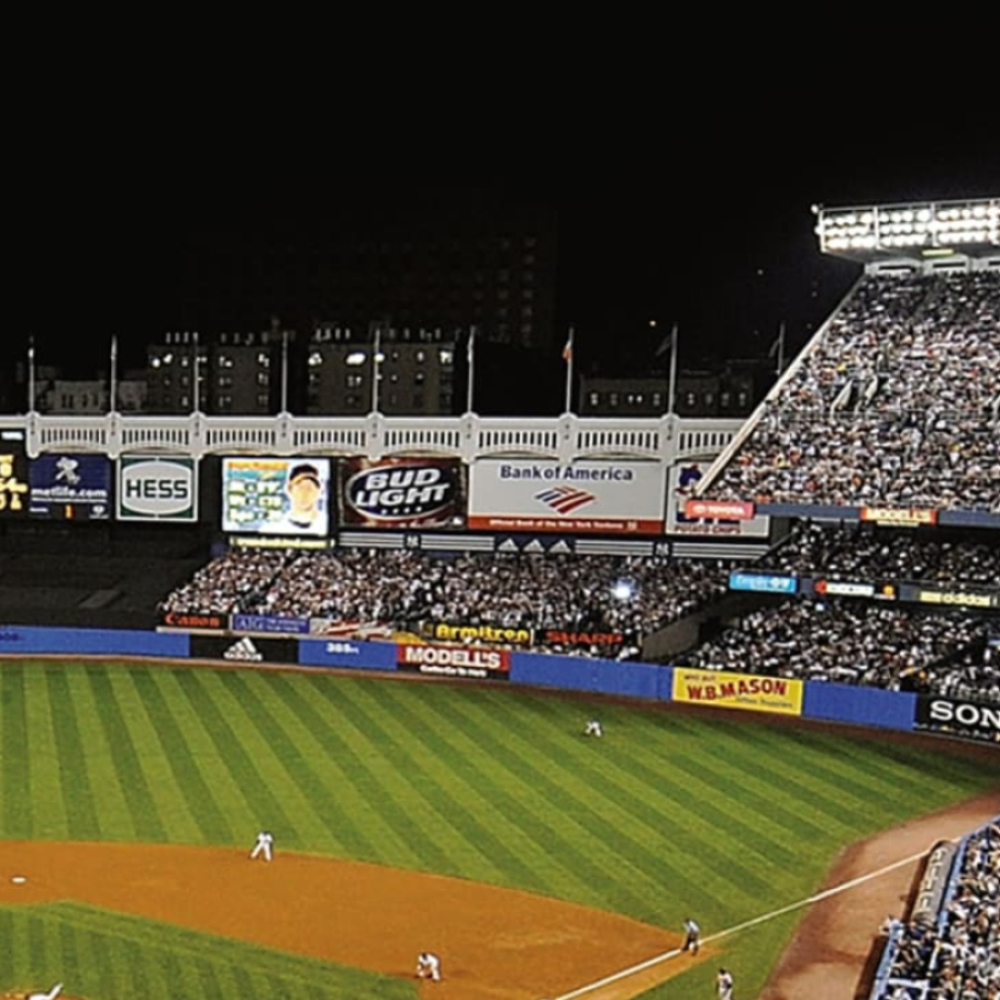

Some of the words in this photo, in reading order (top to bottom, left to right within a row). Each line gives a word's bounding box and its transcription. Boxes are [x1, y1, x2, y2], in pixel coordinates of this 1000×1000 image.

[365, 467, 441, 490] BUD
[500, 465, 541, 479] Bank
[542, 466, 562, 480] of
[563, 467, 633, 481] America
[31, 486, 107, 498] metlife.com
[126, 479, 188, 498] HESS
[355, 483, 450, 507] LIGHT
[165, 613, 221, 628] Canon
[435, 624, 530, 643] Armitron
[546, 630, 624, 644] SHARP
[405, 647, 501, 669] MODELL'S
